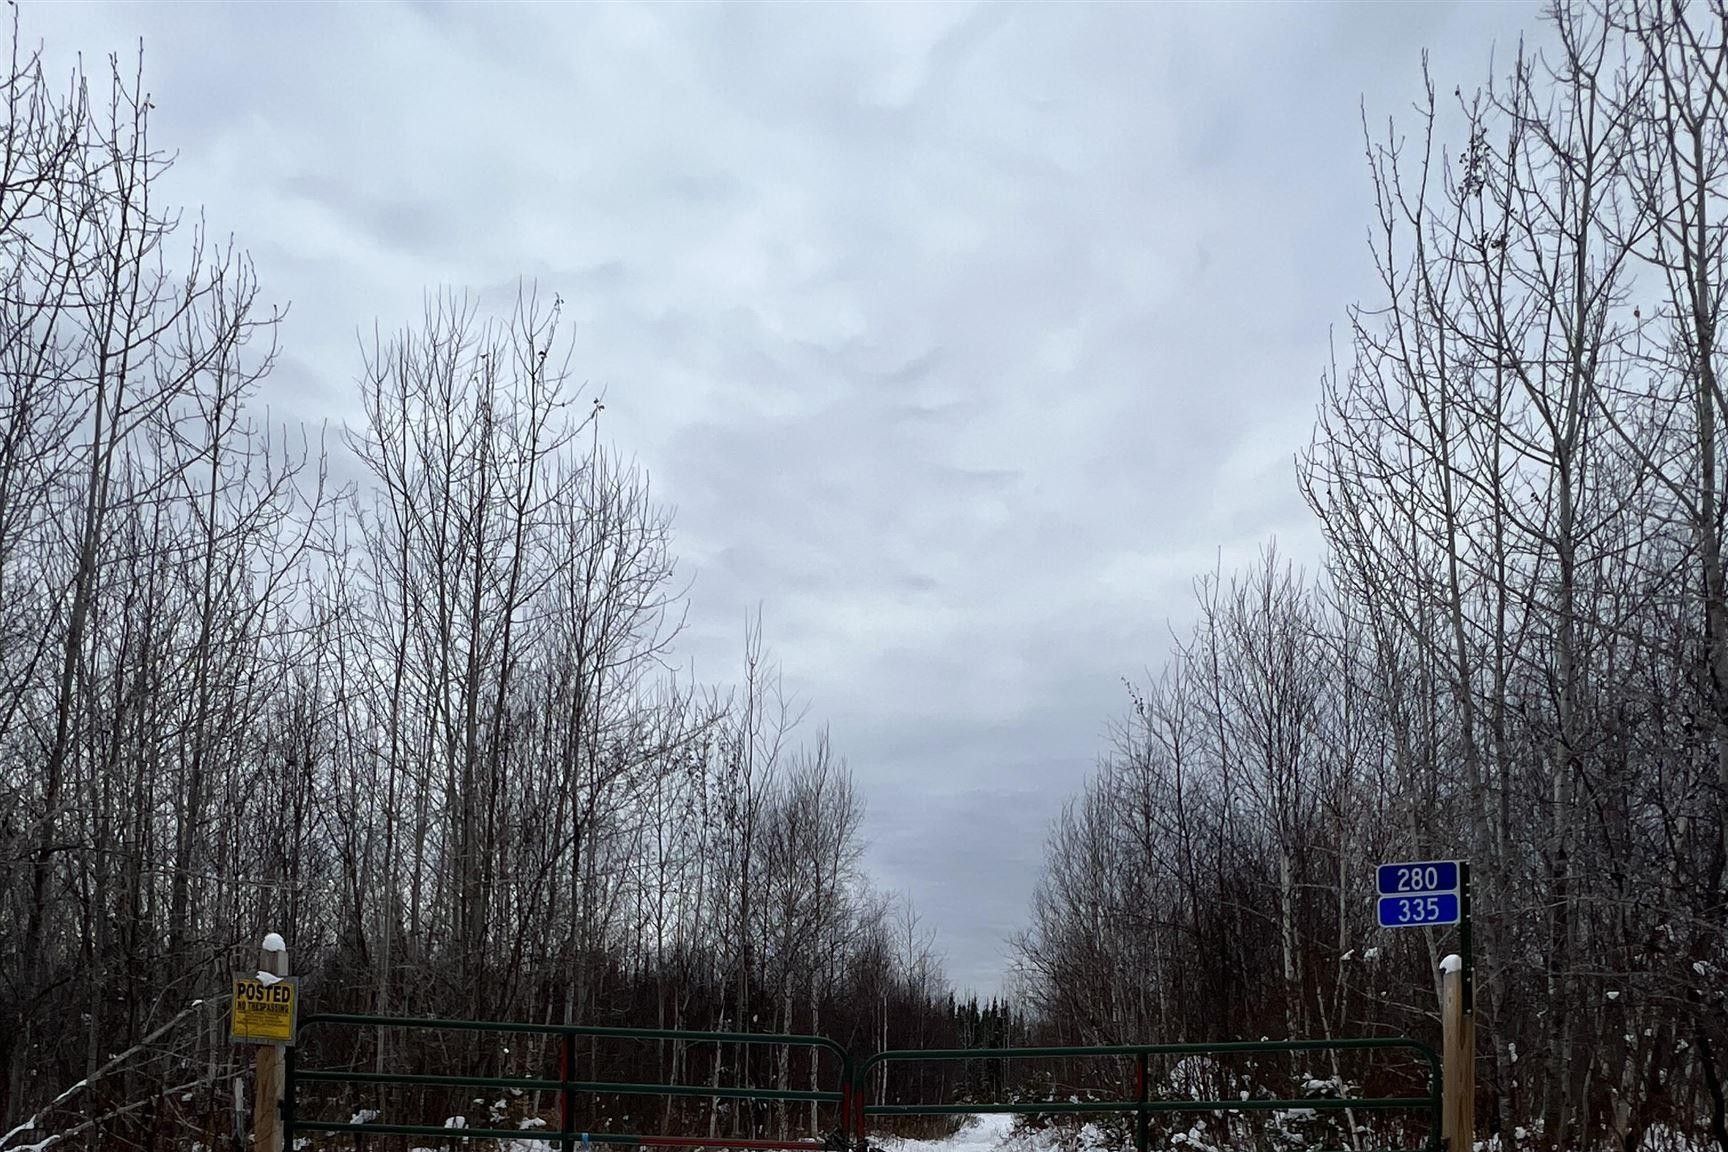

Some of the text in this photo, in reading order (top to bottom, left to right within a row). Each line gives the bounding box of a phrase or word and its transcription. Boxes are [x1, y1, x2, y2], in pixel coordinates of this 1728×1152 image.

[1397, 866, 1438, 891] 280
[1398, 897, 1439, 922] 335
[237, 982, 291, 1003] POSTED
[237, 1000, 247, 1011] NO
